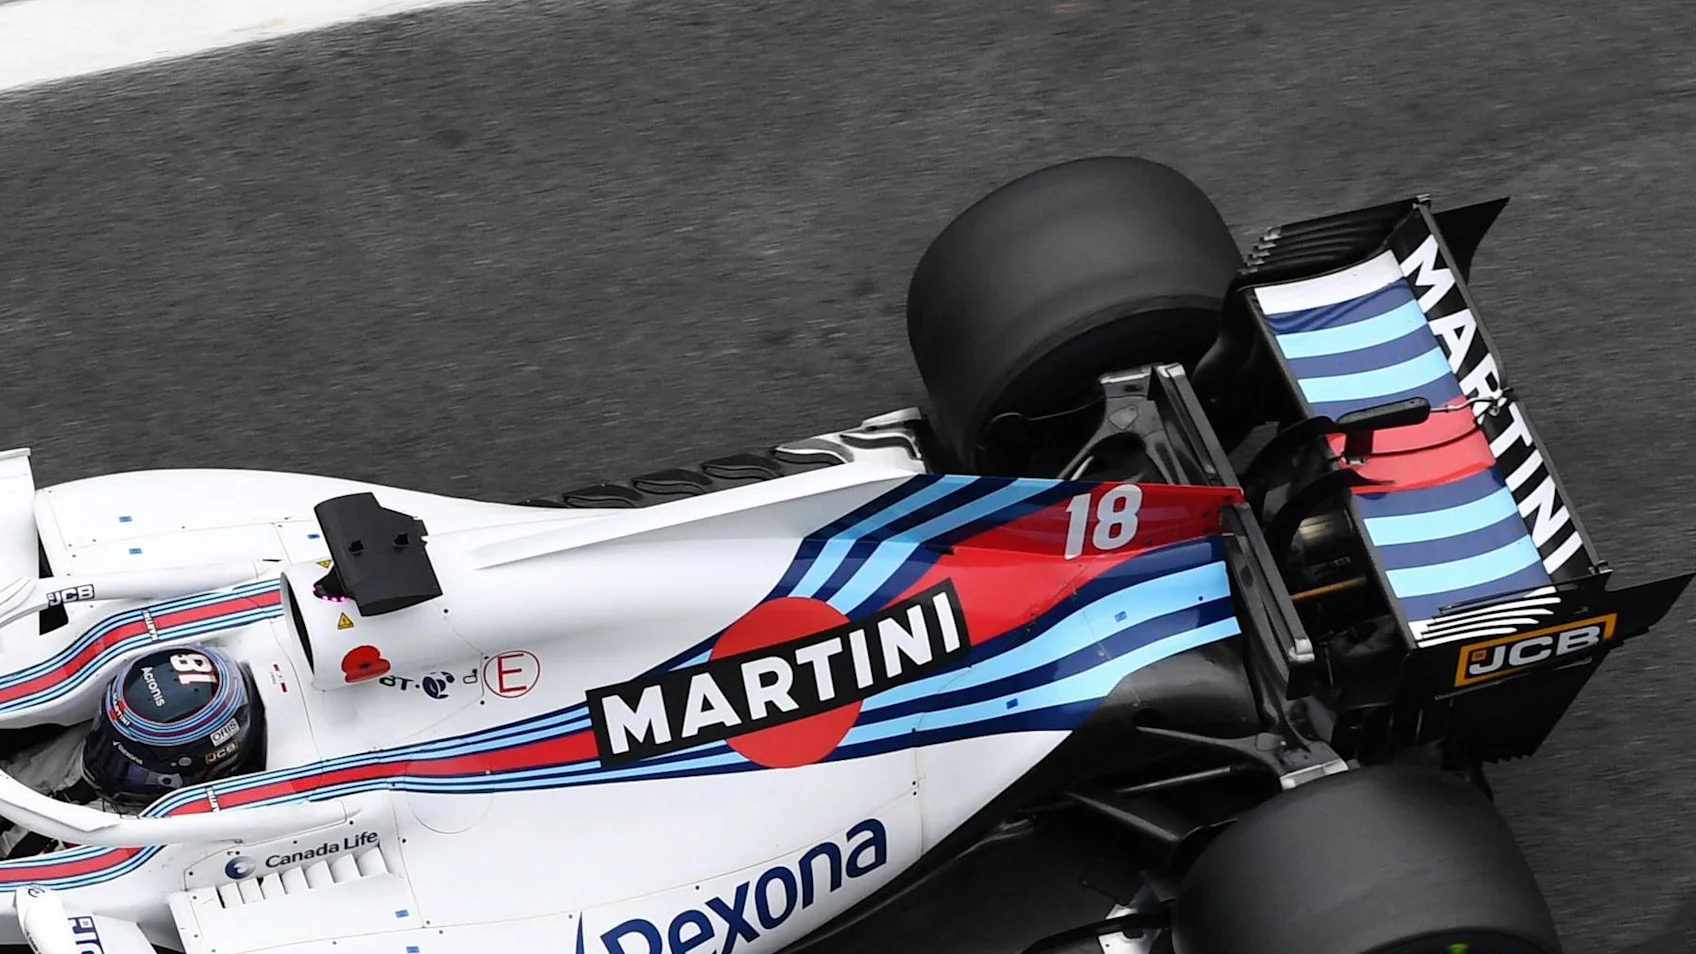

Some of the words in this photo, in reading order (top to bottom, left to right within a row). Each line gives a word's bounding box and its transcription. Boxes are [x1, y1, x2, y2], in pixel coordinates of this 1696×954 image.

[1400, 234, 1584, 574] MARTINI
[1064, 483, 1143, 560] 18
[48, 585, 94, 606] JCB
[170, 653, 216, 685] 18
[1469, 626, 1601, 675] JCB
[140, 666, 165, 707] Acronis
[497, 653, 528, 693] E
[601, 591, 961, 755] MARTINI
[265, 843, 339, 868] Canada
[344, 831, 378, 850] Life
